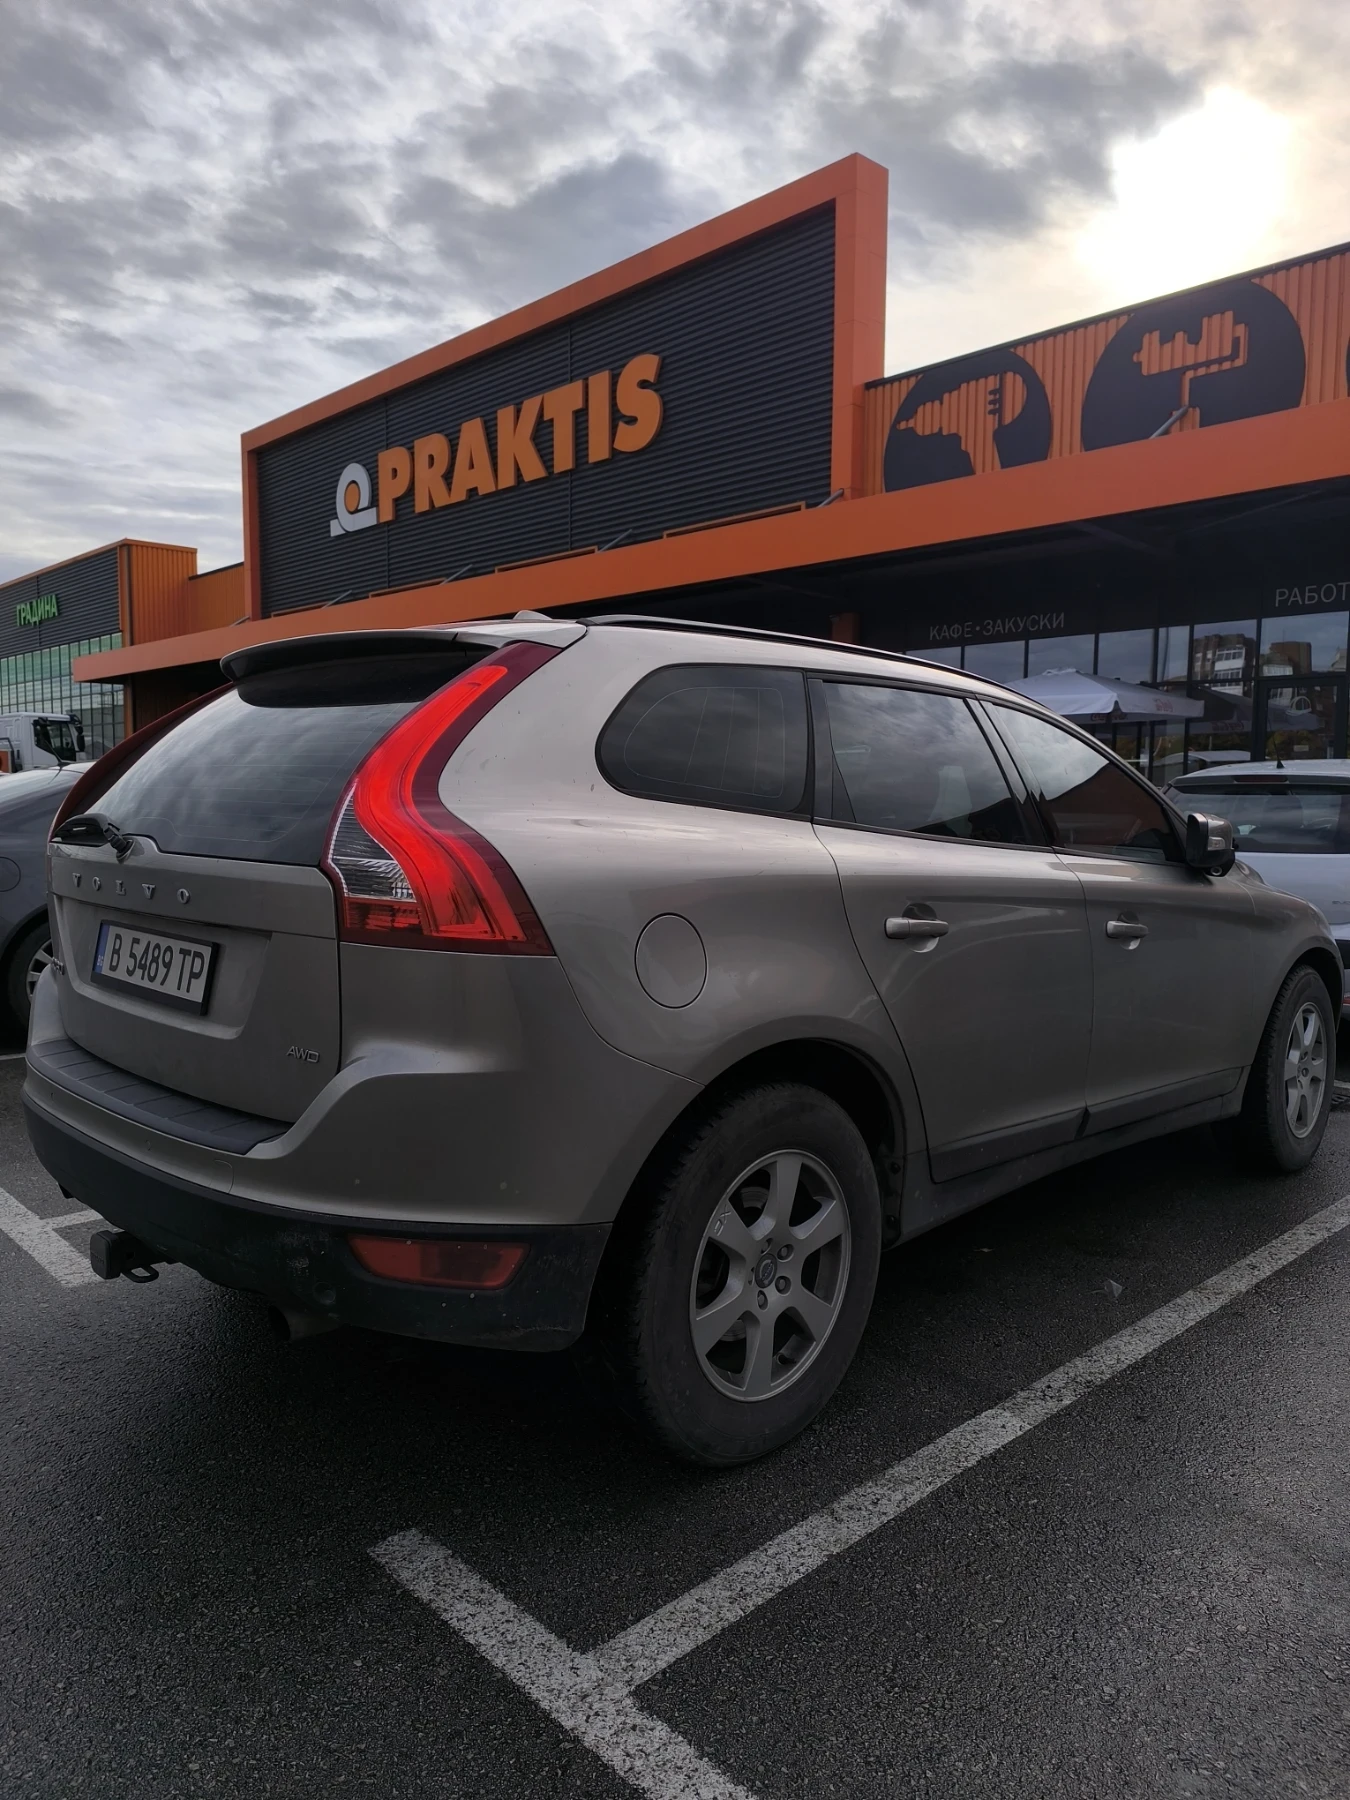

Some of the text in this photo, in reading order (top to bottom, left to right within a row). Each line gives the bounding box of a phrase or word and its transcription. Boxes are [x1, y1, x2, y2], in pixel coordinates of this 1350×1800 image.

[377, 353, 663, 523] PRAKTIS
[16, 594, 58, 627] ГРАДИНА
[72, 872, 191, 904] VOLVO
[109, 933, 122, 972] B
[126, 937, 174, 986] 5489
[176, 947, 205, 993] TP
[286, 1045, 320, 1063] AWD
